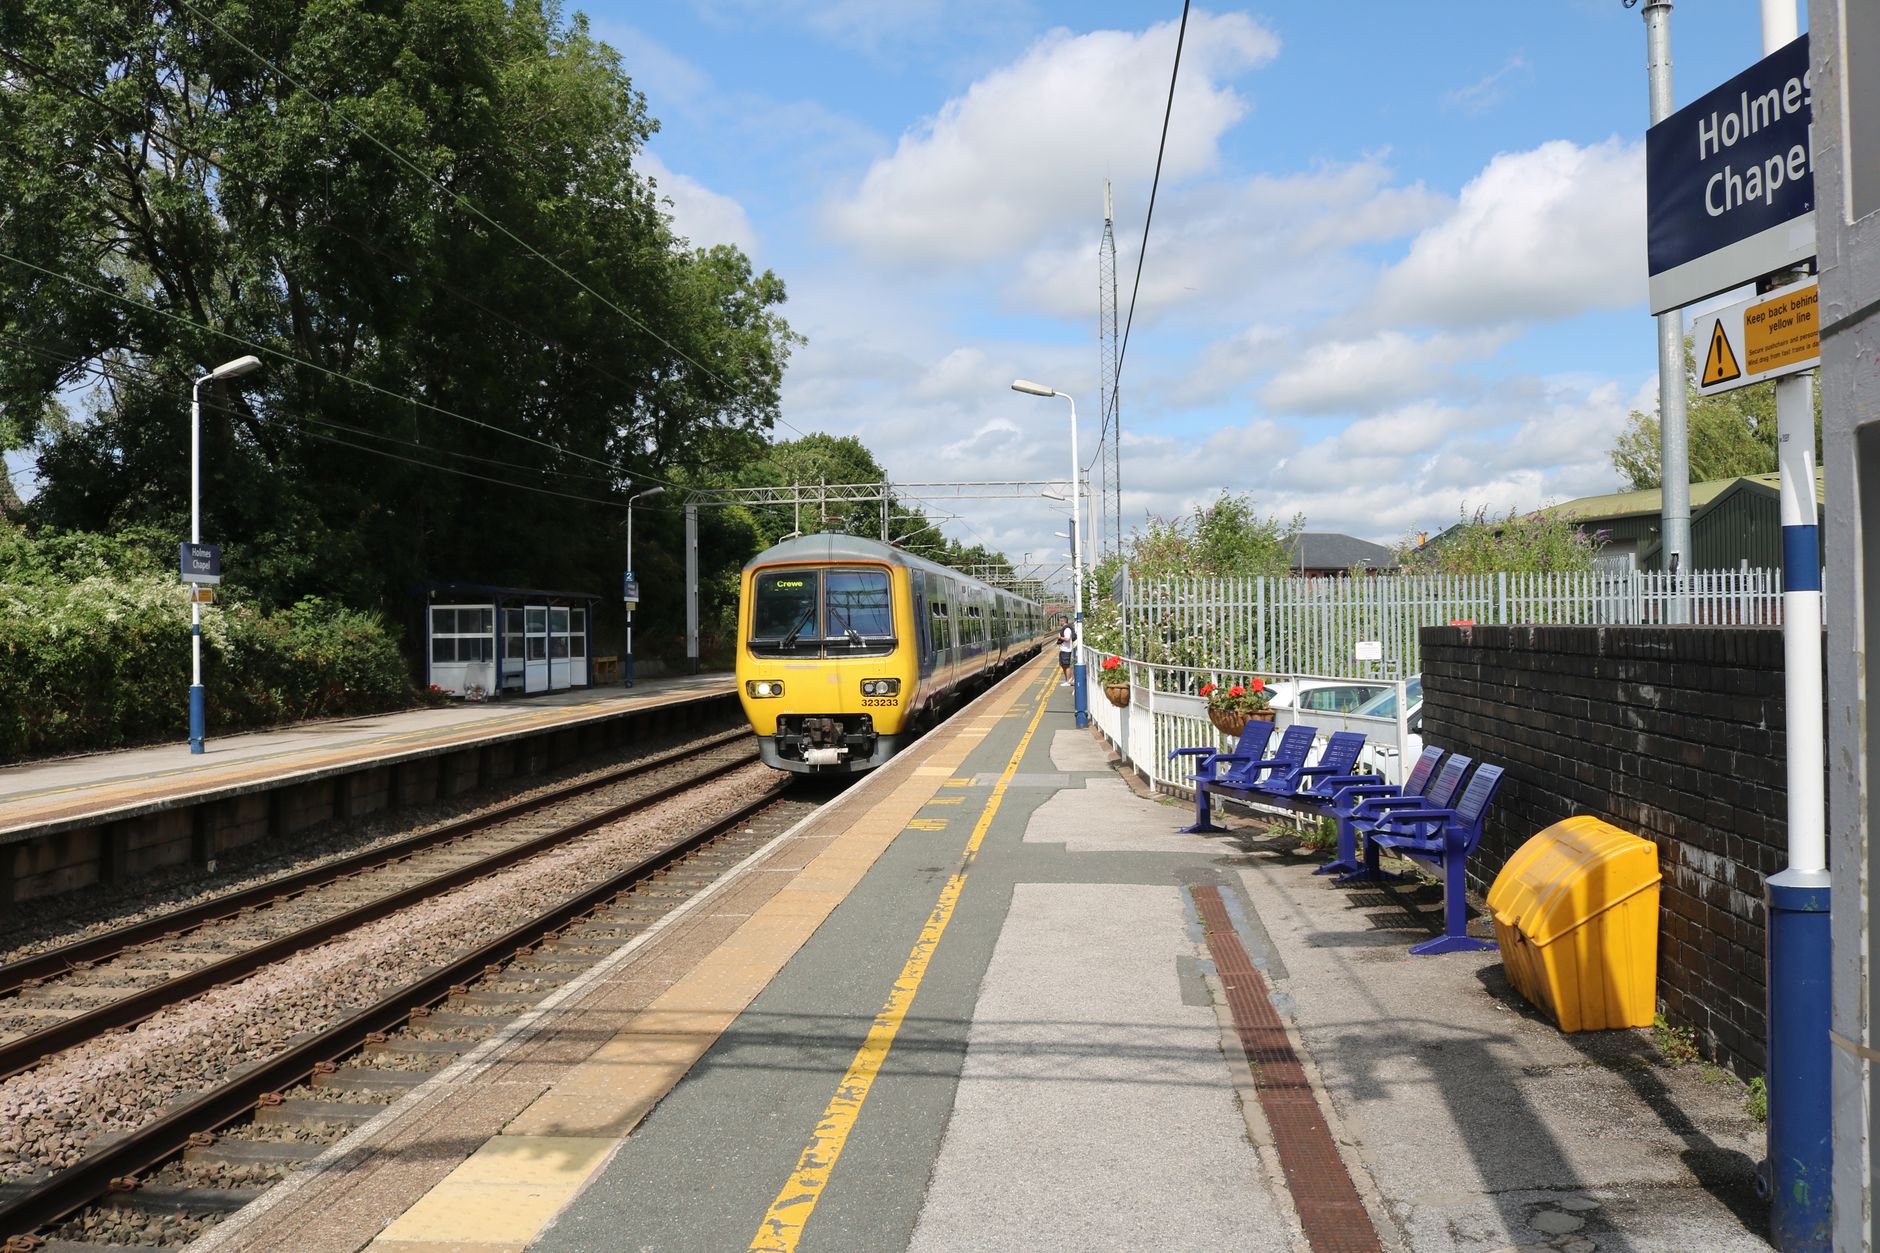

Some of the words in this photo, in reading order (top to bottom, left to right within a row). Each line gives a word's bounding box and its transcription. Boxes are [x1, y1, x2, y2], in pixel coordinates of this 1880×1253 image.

[1705, 123, 1814, 217] Chapel
[1746, 312, 1766, 326] Keep
[1768, 303, 1788, 318] back
[1790, 291, 1818, 310] behind
[1769, 317, 1793, 334] yellow
[1796, 311, 1811, 324] line
[1748, 358, 1758, 366] Wind
[1759, 355, 1769, 363] drag
[1770, 352, 1781, 360] from
[1792, 345, 1805, 353] trains
[1749, 347, 1764, 356] Secure
[1790, 336, 1799, 344] and
[192, 547, 212, 558] Holmes
[192, 560, 211, 572] Chapel
[776, 580, 803, 588] Crewe
[861, 698, 899, 707] 323233
